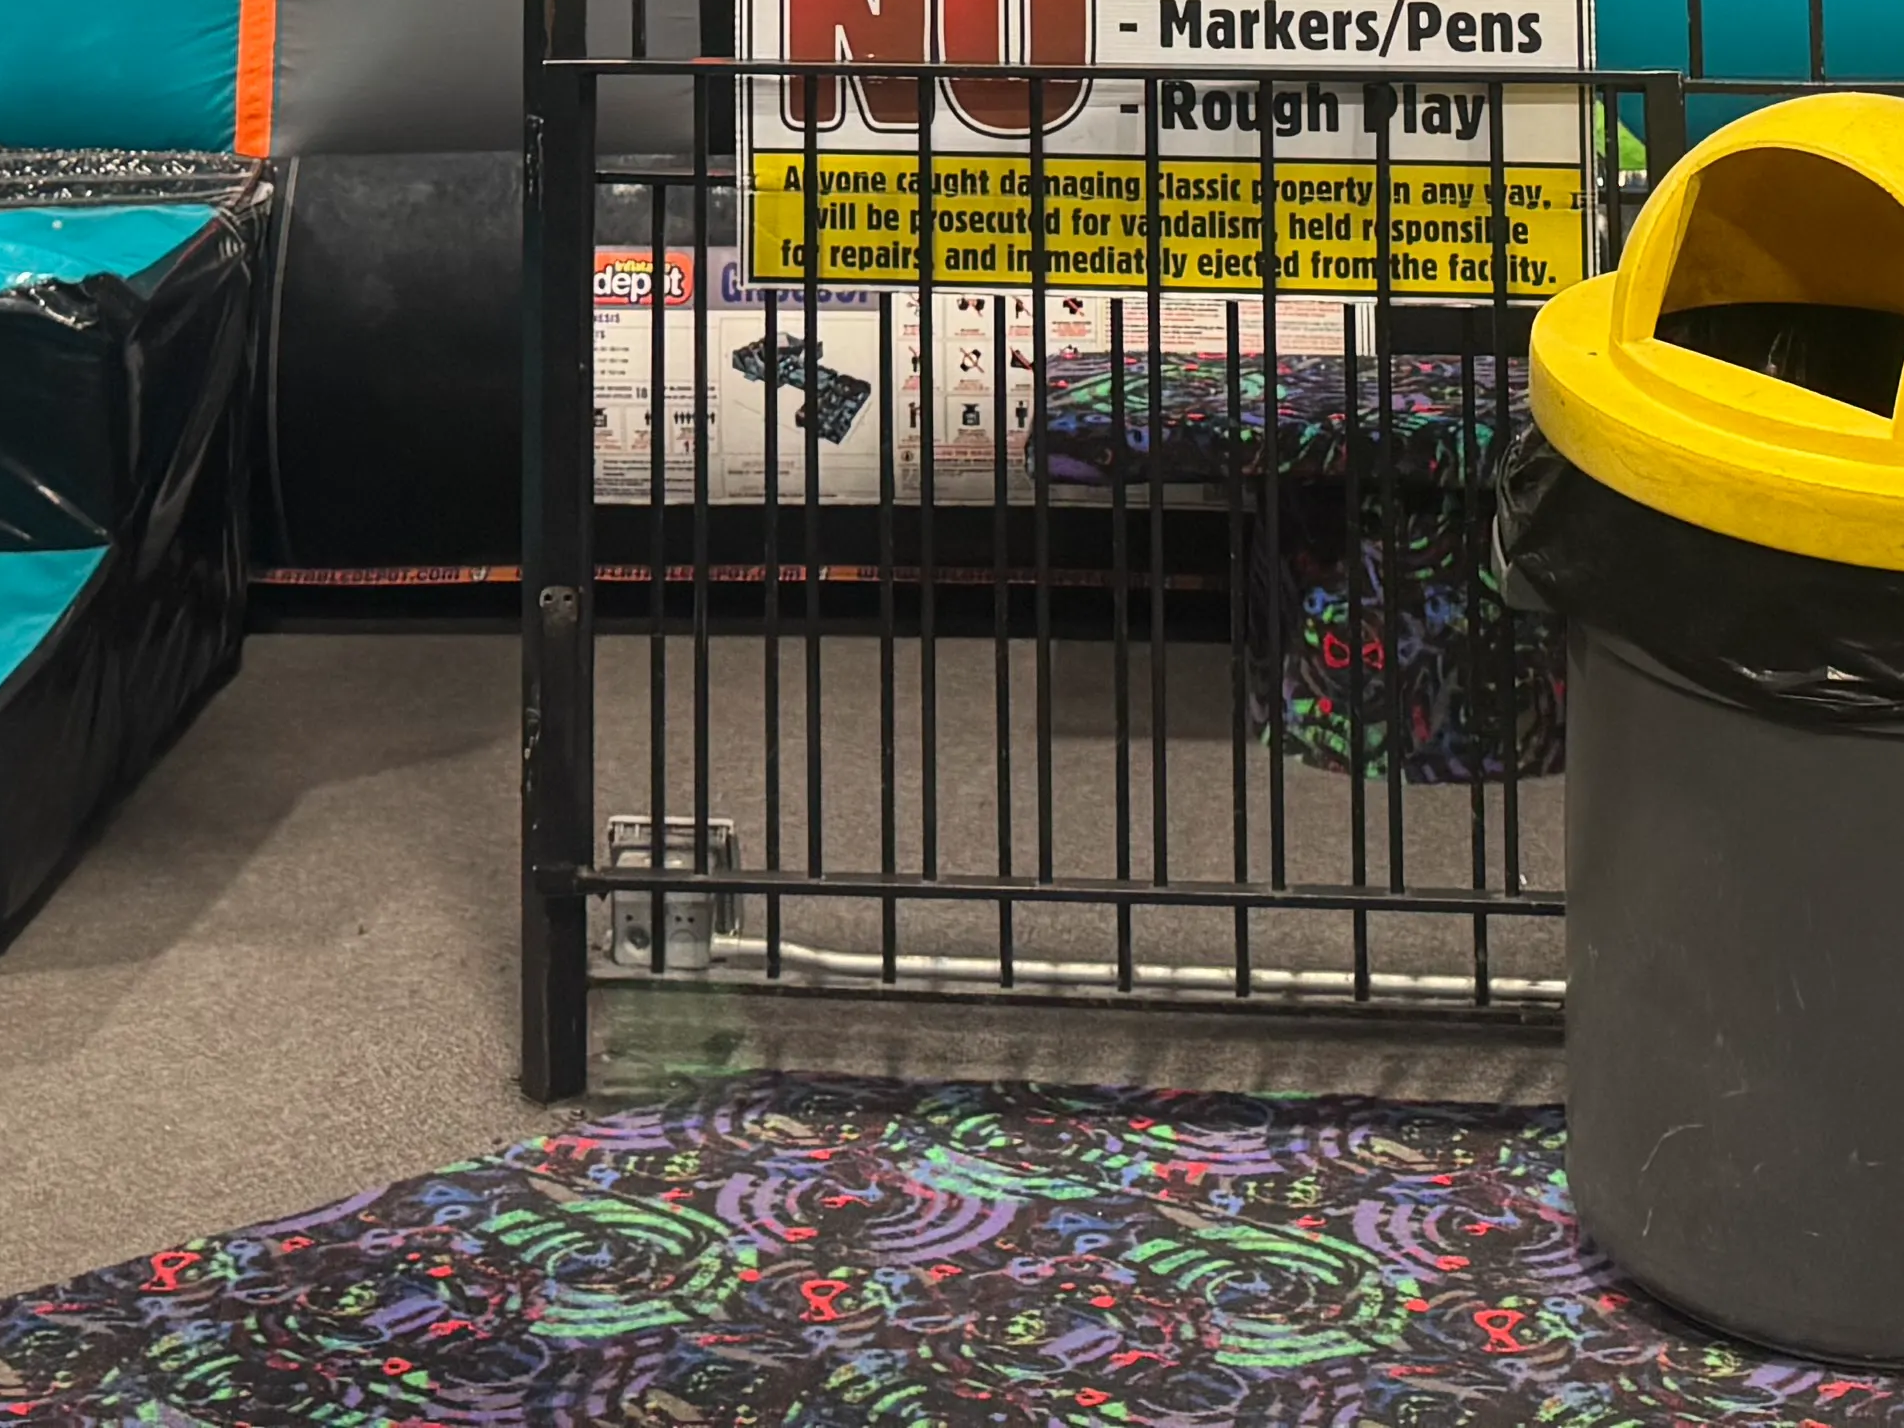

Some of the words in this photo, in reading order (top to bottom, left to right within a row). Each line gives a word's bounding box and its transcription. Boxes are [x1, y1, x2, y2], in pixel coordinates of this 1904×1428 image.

[1160, 81, 1339, 136] Rough
[784, 166, 886, 195] Ayone
[1001, 169, 1140, 201] damaging
[1422, 182, 1475, 208] any
[867, 203, 900, 232] be
[910, 207, 1060, 236] posecutd
[1072, 208, 1111, 235] for
[1289, 212, 1352, 241] held
[1363, 216, 1529, 245] rsponsile
[781, 239, 820, 267] fo
[945, 243, 996, 271] and
[1008, 244, 1188, 278] immediatly
[1312, 251, 1379, 279] from
[1389, 252, 1438, 281] the
[1449, 253, 1557, 285] facity.
